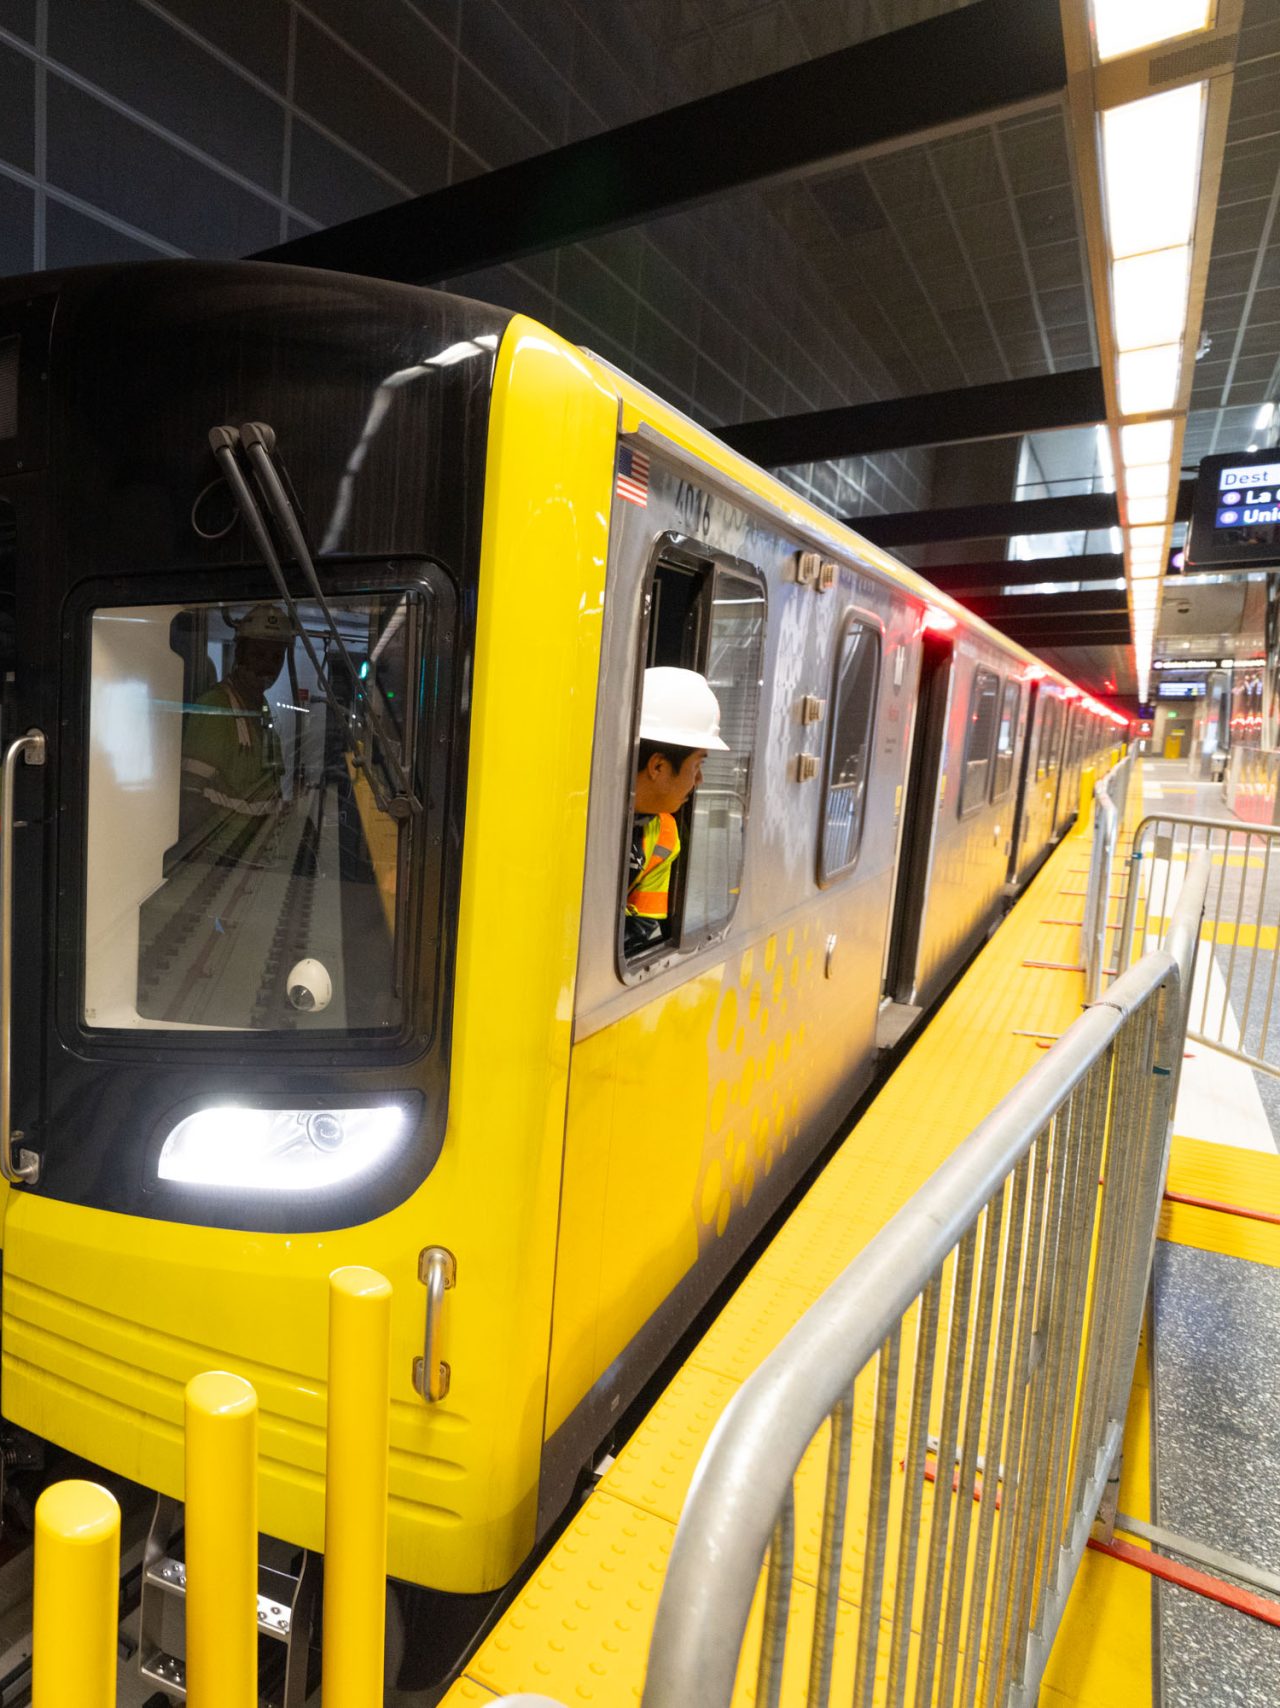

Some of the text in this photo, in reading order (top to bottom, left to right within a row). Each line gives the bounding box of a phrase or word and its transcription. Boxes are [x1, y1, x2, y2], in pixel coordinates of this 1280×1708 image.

[1224, 471, 1269, 486] Dest
[1245, 490, 1272, 504] La
[675, 479, 711, 537] 4016
